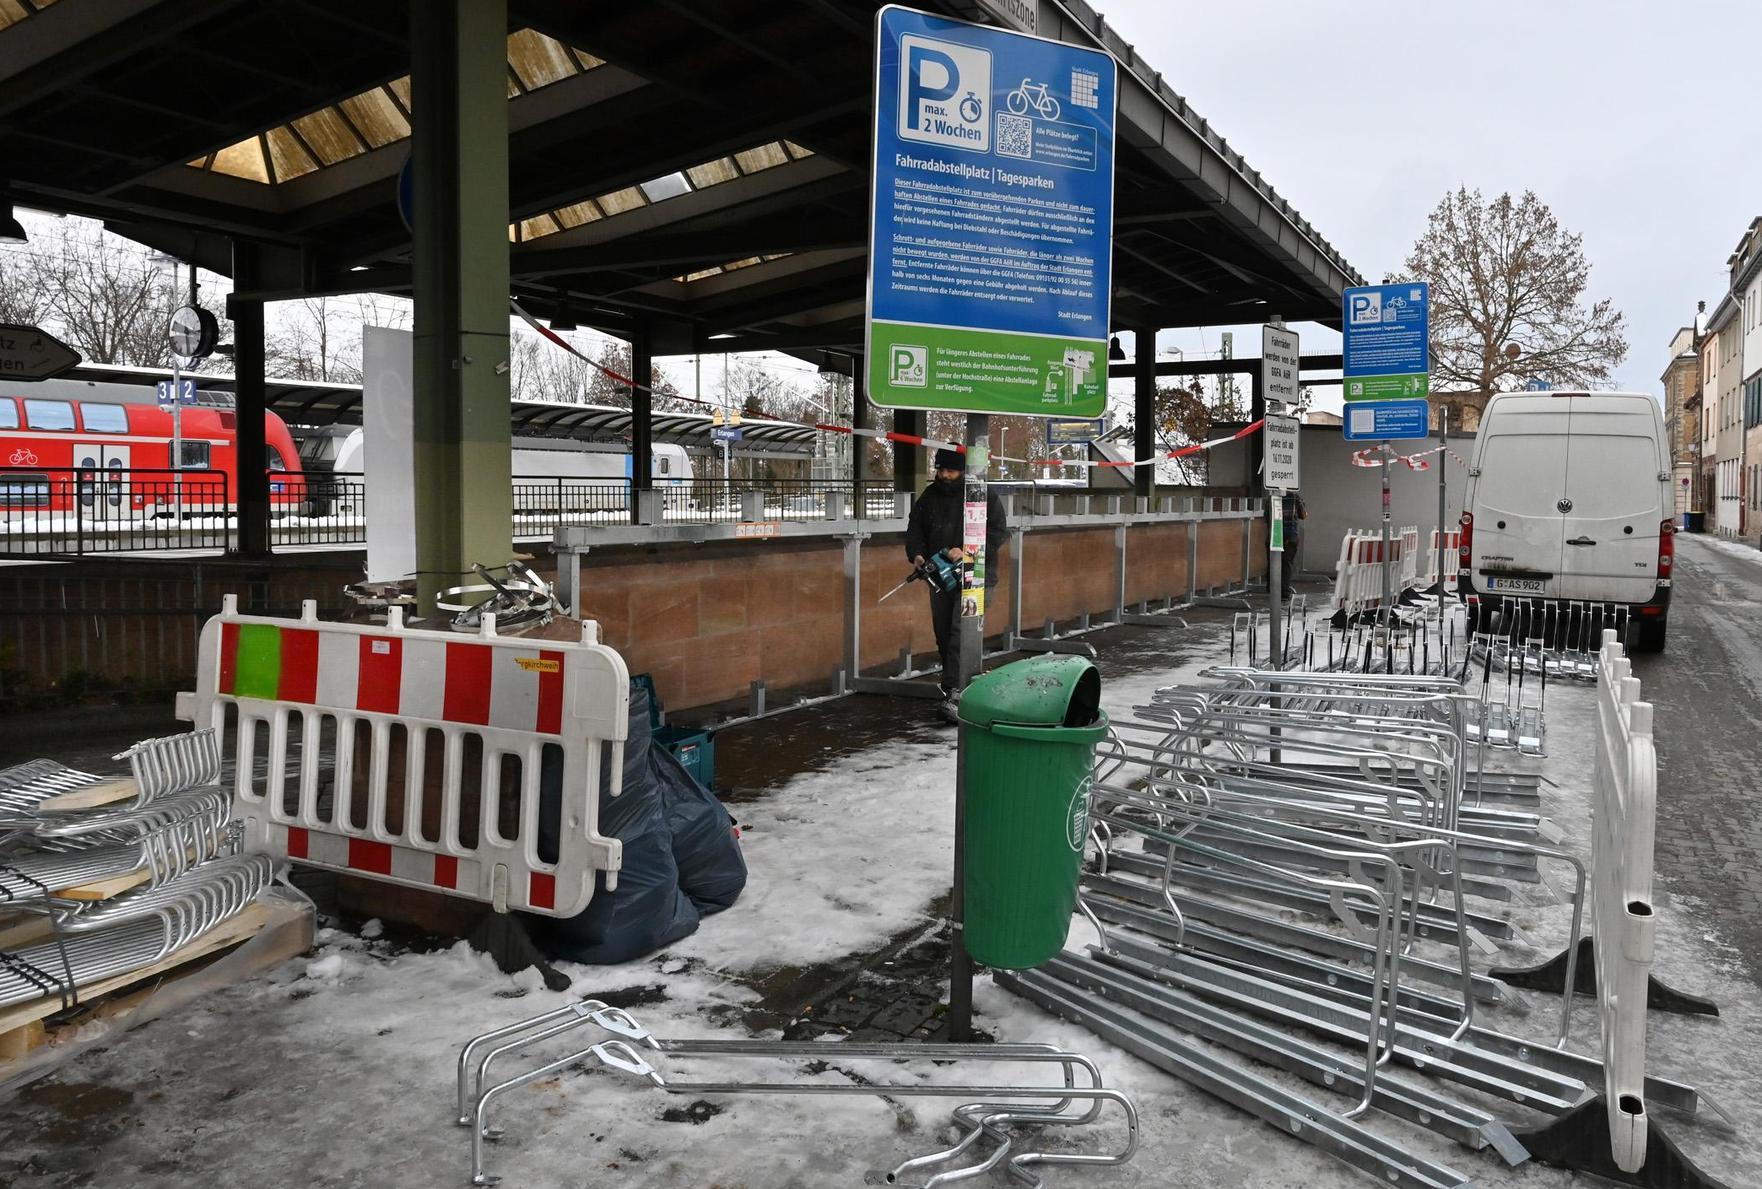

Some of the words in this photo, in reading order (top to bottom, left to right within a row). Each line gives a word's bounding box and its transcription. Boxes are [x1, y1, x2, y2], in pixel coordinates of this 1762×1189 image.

[907, 45, 960, 130] P
[924, 104, 947, 116] max.
[923, 117, 931, 132] 2
[934, 119, 981, 140] Wochen
[1036, 127, 1044, 135] Alle
[1045, 128, 1060, 137] Plätze
[1061, 131, 1078, 142] belegt?
[895, 153, 990, 182] Fahrradabstellplatz
[997, 169, 1054, 192] Tagesparken
[891, 282, 918, 291] Zeitraums
[918, 285, 938, 293] werden
[948, 288, 973, 297] Fahrräder
[974, 291, 995, 300] entsorgt
[1008, 294, 1034, 303] verwertet.
[1057, 310, 1070, 318] Stadt
[1071, 312, 1092, 321] Erlangen
[1271, 336, 1291, 350] Fahrräder
[945, 348, 968, 357] längeres
[968, 350, 992, 358] Abstellen
[1007, 353, 1030, 361] Fahrrades
[0, 360, 25, 371] en
[950, 360, 971, 368] westlich
[981, 363, 1038, 374] Bahnhofsunterführung
[160, 382, 167, 399] 3
[184, 380, 192, 398] 2
[944, 383, 973, 392] Verfügung.
[718, 429, 735, 438] Erlangen
[1523, 581, 1540, 591] 902
